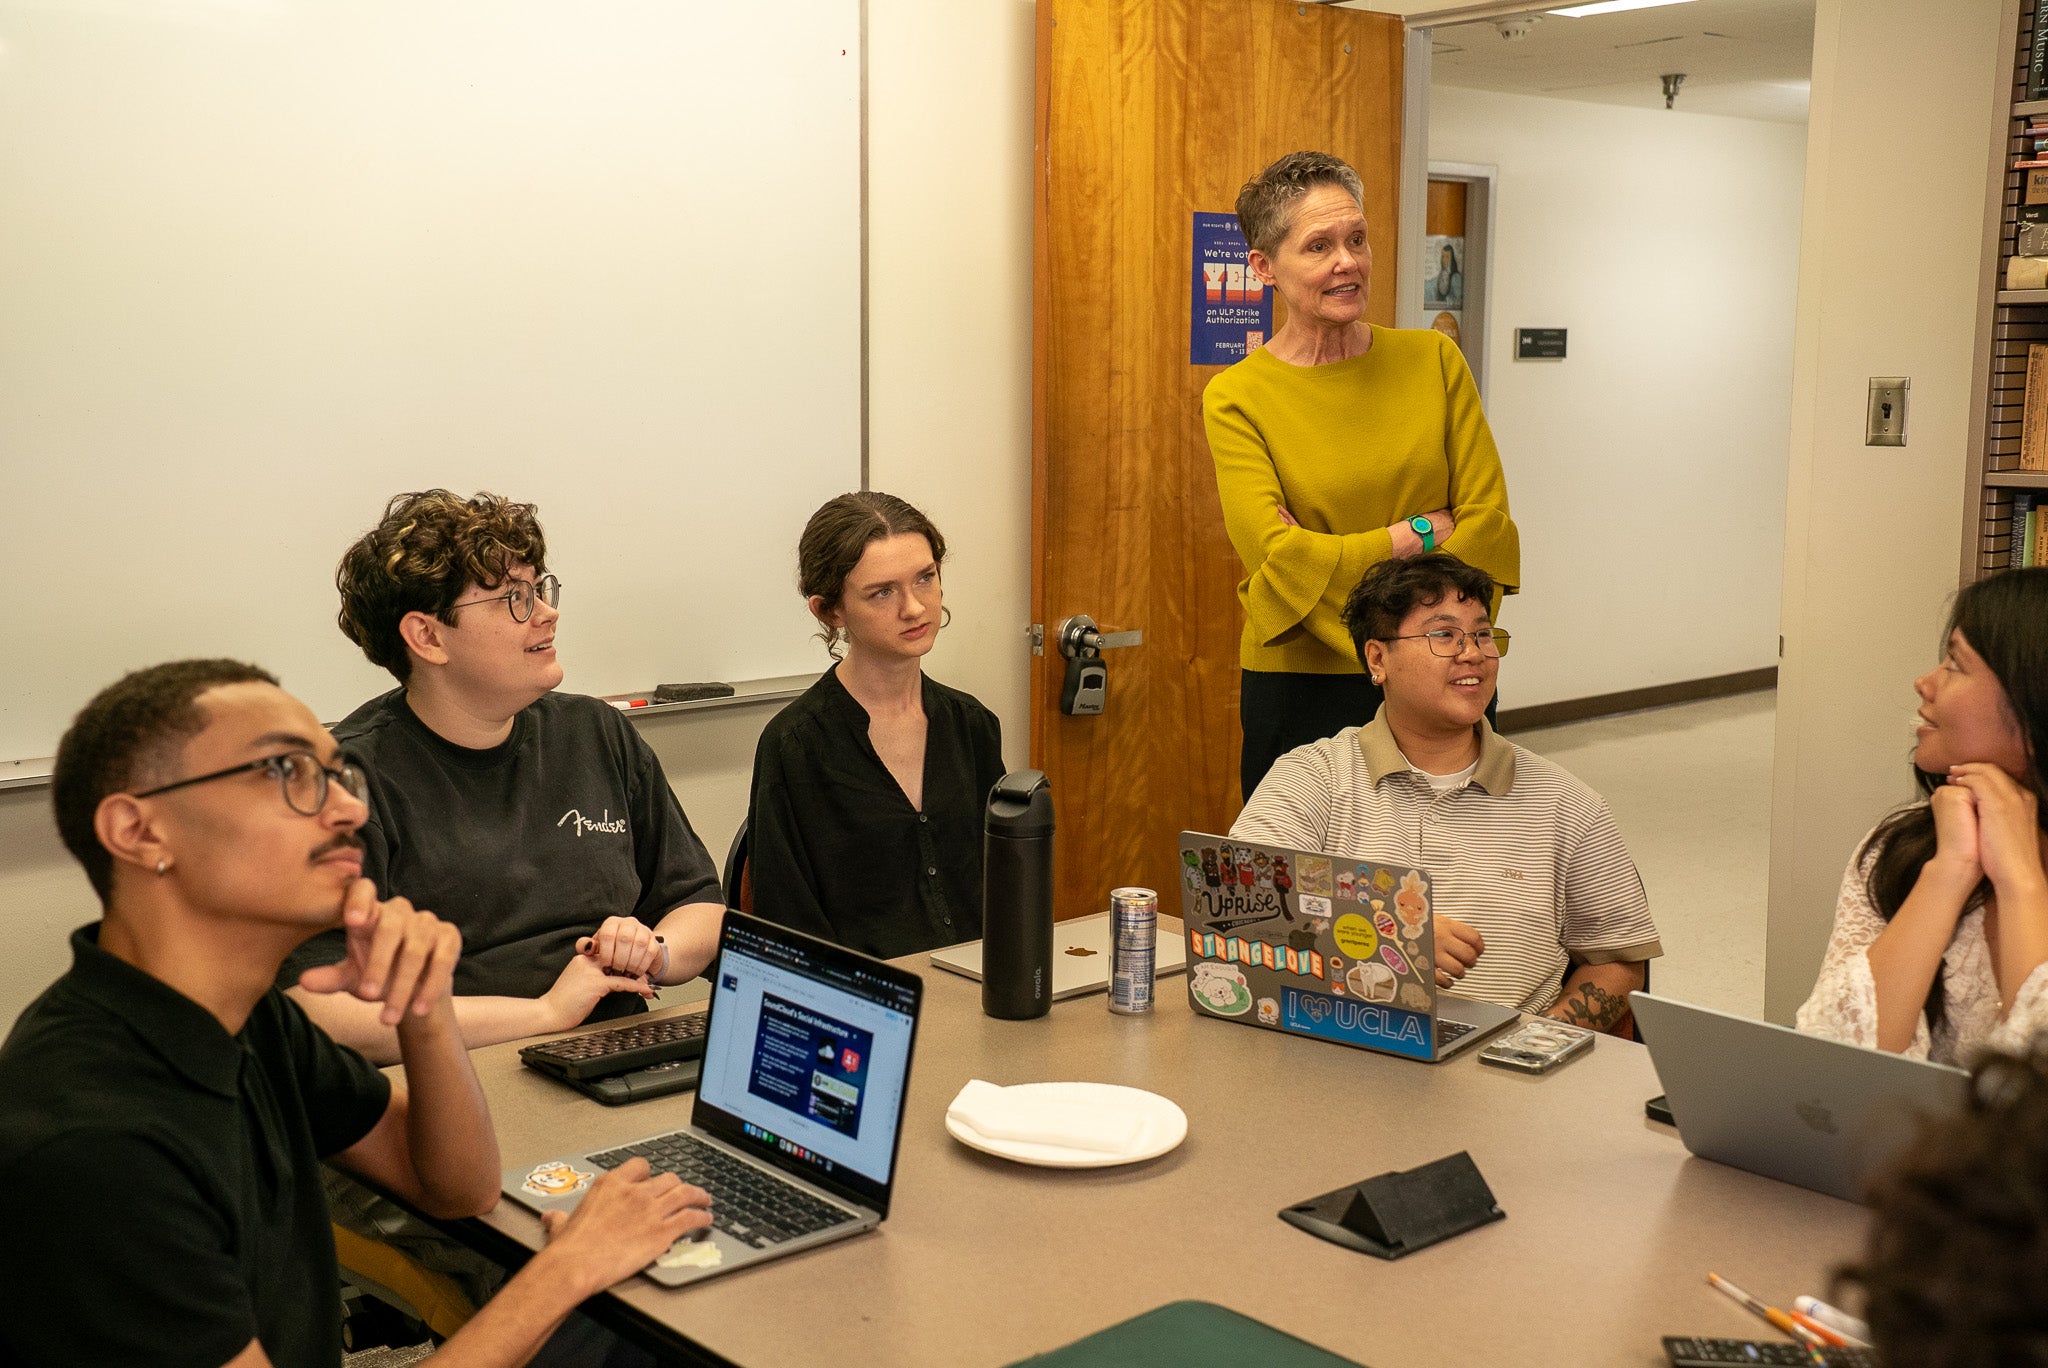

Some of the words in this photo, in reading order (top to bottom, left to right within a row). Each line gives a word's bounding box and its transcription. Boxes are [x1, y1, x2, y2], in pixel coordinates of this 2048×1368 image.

[2034, 28, 2048, 73] MUSIC
[1204, 249, 1231, 258] We're
[1233, 250, 1249, 259] vot
[1203, 263, 1263, 302] YES
[1205, 316, 1260, 325] Authorization
[1219, 308, 1235, 316] ULP
[1236, 308, 1260, 317] Strike
[557, 808, 626, 837] Fender
[1192, 930, 1323, 980] STRANGELOVE
[1034, 967, 1042, 1000] owala
[1289, 991, 1297, 1019] I
[1335, 1000, 1426, 1046] UCLA
